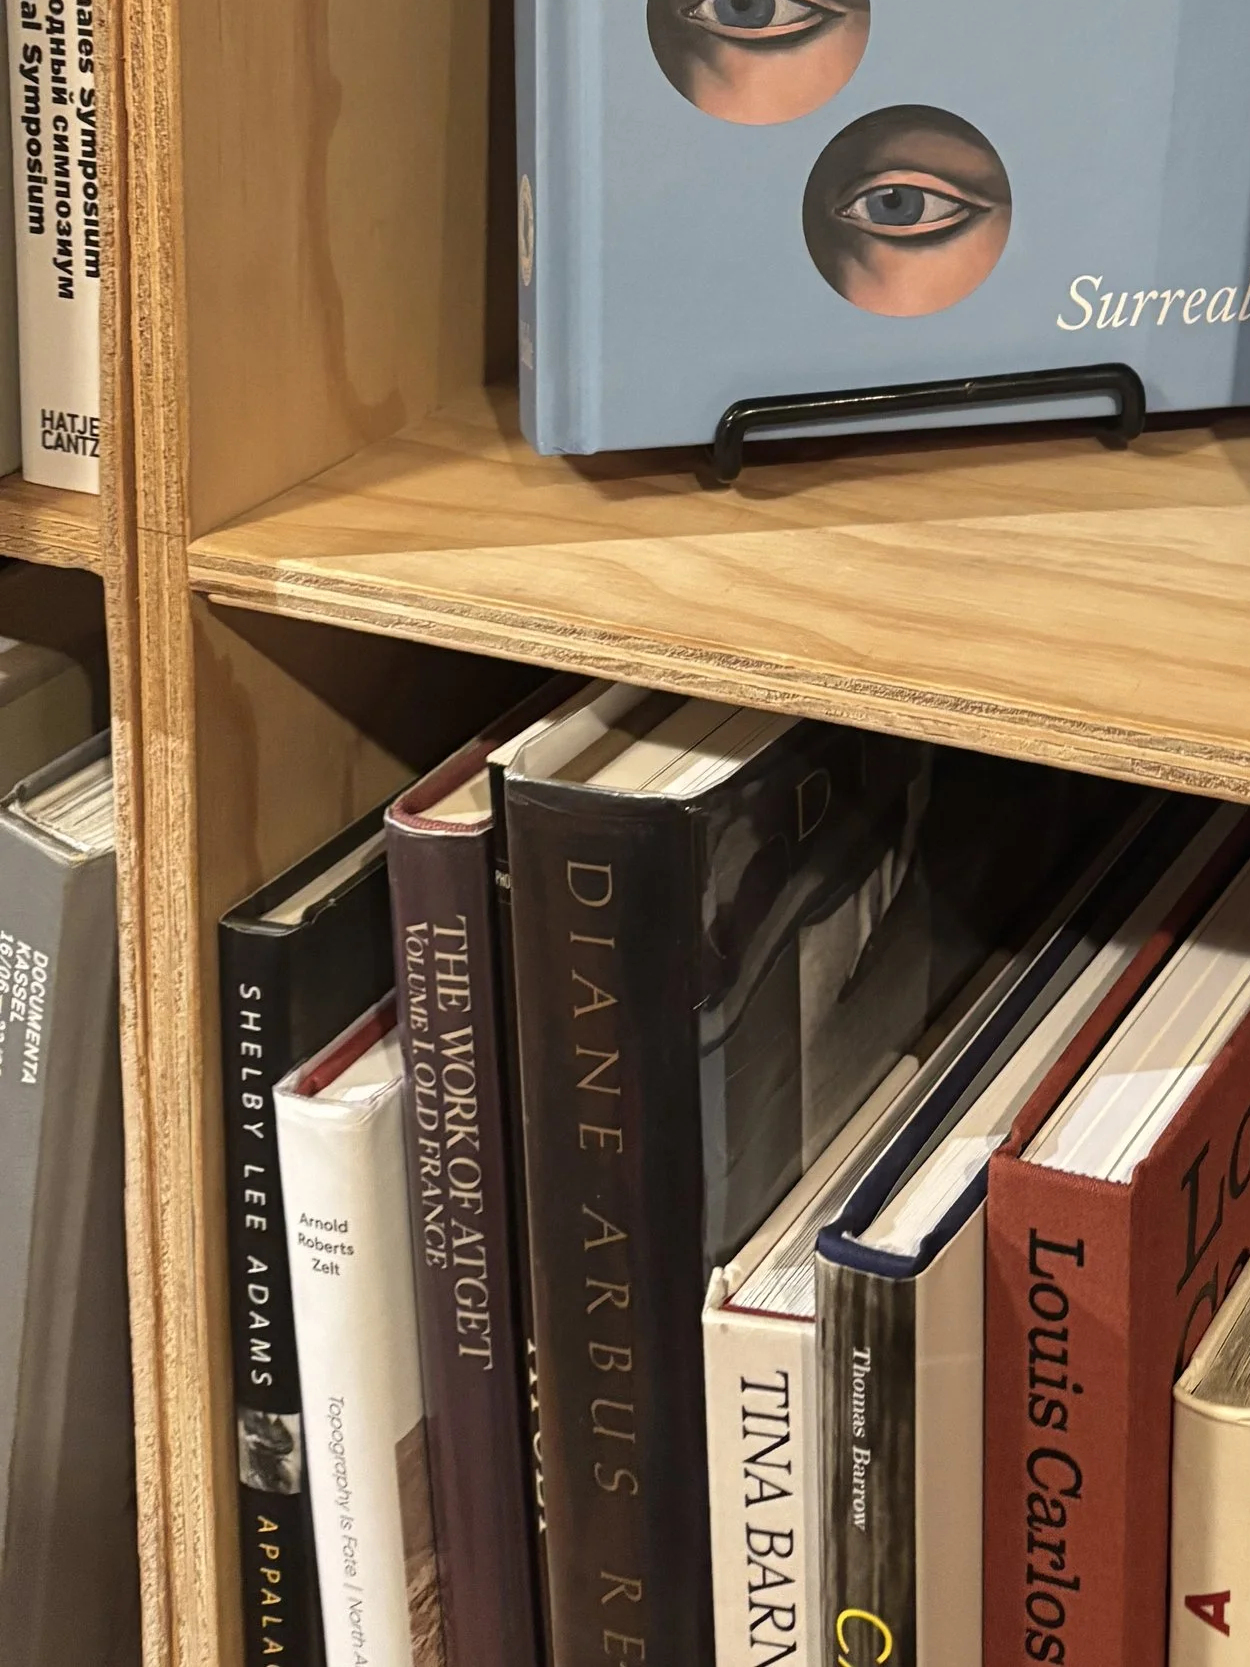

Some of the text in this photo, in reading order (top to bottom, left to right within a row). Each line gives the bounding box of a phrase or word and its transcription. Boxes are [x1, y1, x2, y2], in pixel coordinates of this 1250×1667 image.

[20, 42, 48, 235] Symposium
[75, 86, 101, 279] Symposium
[52, 114, 75, 300] симпозиум
[41, 408, 100, 435] HATJE
[41, 430, 100, 458] CANTZ
[9, 940, 32, 1023] KASSEL
[21, 950, 49, 1084] DOCUMENTA
[404, 921, 429, 1033] VOLUME
[565, 860, 623, 1156] DIANE
[414, 1060, 440, 1132] OLD
[433, 915, 494, 1371] THE WORK OF ATGET
[240, 983, 273, 1387] SHELBY LEE ADAMS
[297, 1232, 355, 1256] Roberts
[298, 1212, 349, 1234] Arnold
[418, 1136, 448, 1270] FRANCE
[311, 1257, 341, 1276] Zelt
[581, 1200, 639, 1500] ARBUS
[328, 1396, 353, 1512] Topography
[740, 1370, 793, 1508] TINA
[852, 1346, 872, 1532] Thomas Barrow
[1024, 1227, 1085, 1666] Louis Carlos
[257, 1514, 285, 1667] APPALA
[343, 1536, 359, 1578] Fate
[348, 1596, 370, 1649] North
